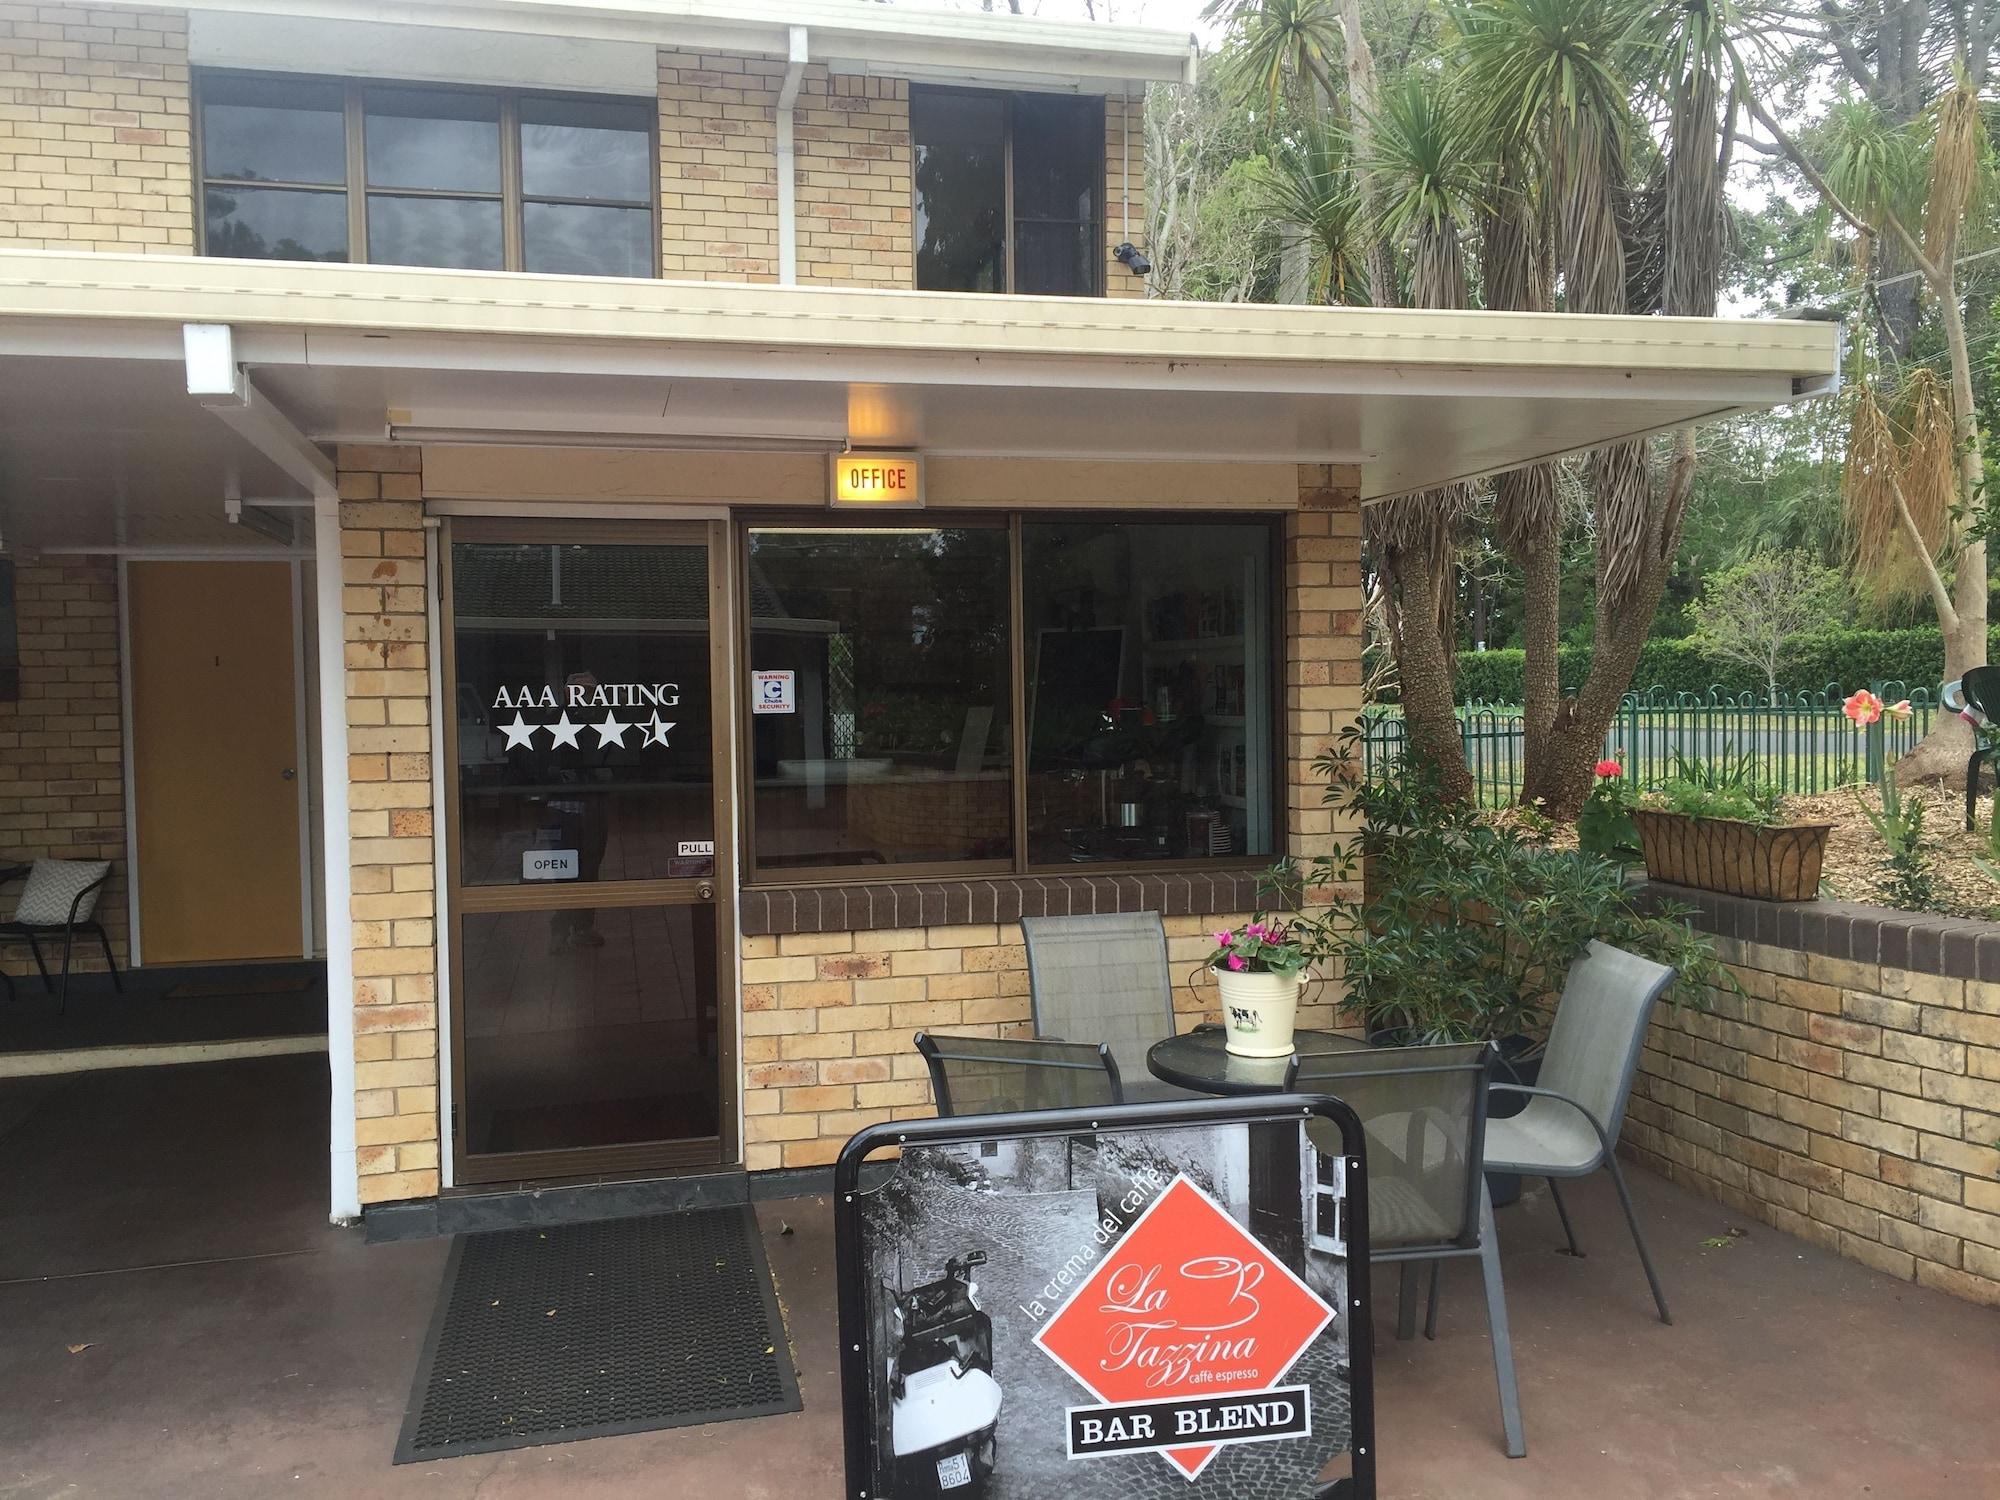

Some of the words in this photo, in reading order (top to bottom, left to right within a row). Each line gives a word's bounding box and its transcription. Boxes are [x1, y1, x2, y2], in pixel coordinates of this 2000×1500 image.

[851, 468, 906, 489] OFFICE
[492, 684, 559, 709] AAA
[567, 683, 680, 708] RATING
[681, 844, 712, 853] PULL
[534, 859, 568, 870] OPEN
[1019, 1300, 1047, 1321] la
[1044, 1244, 1096, 1300] crema
[1093, 1208, 1123, 1244] del
[1120, 1165, 1163, 1214] caffè
[1099, 1264, 1170, 1313] La
[1100, 1319, 1259, 1388] Tazzina
[1189, 1370, 1213, 1384] caffè
[1216, 1368, 1258, 1384] espresso
[1080, 1414, 1155, 1444] BAR
[1175, 1401, 1295, 1435] BLEND
[953, 1455, 966, 1470] 51
[942, 1468, 969, 1487] 8604
